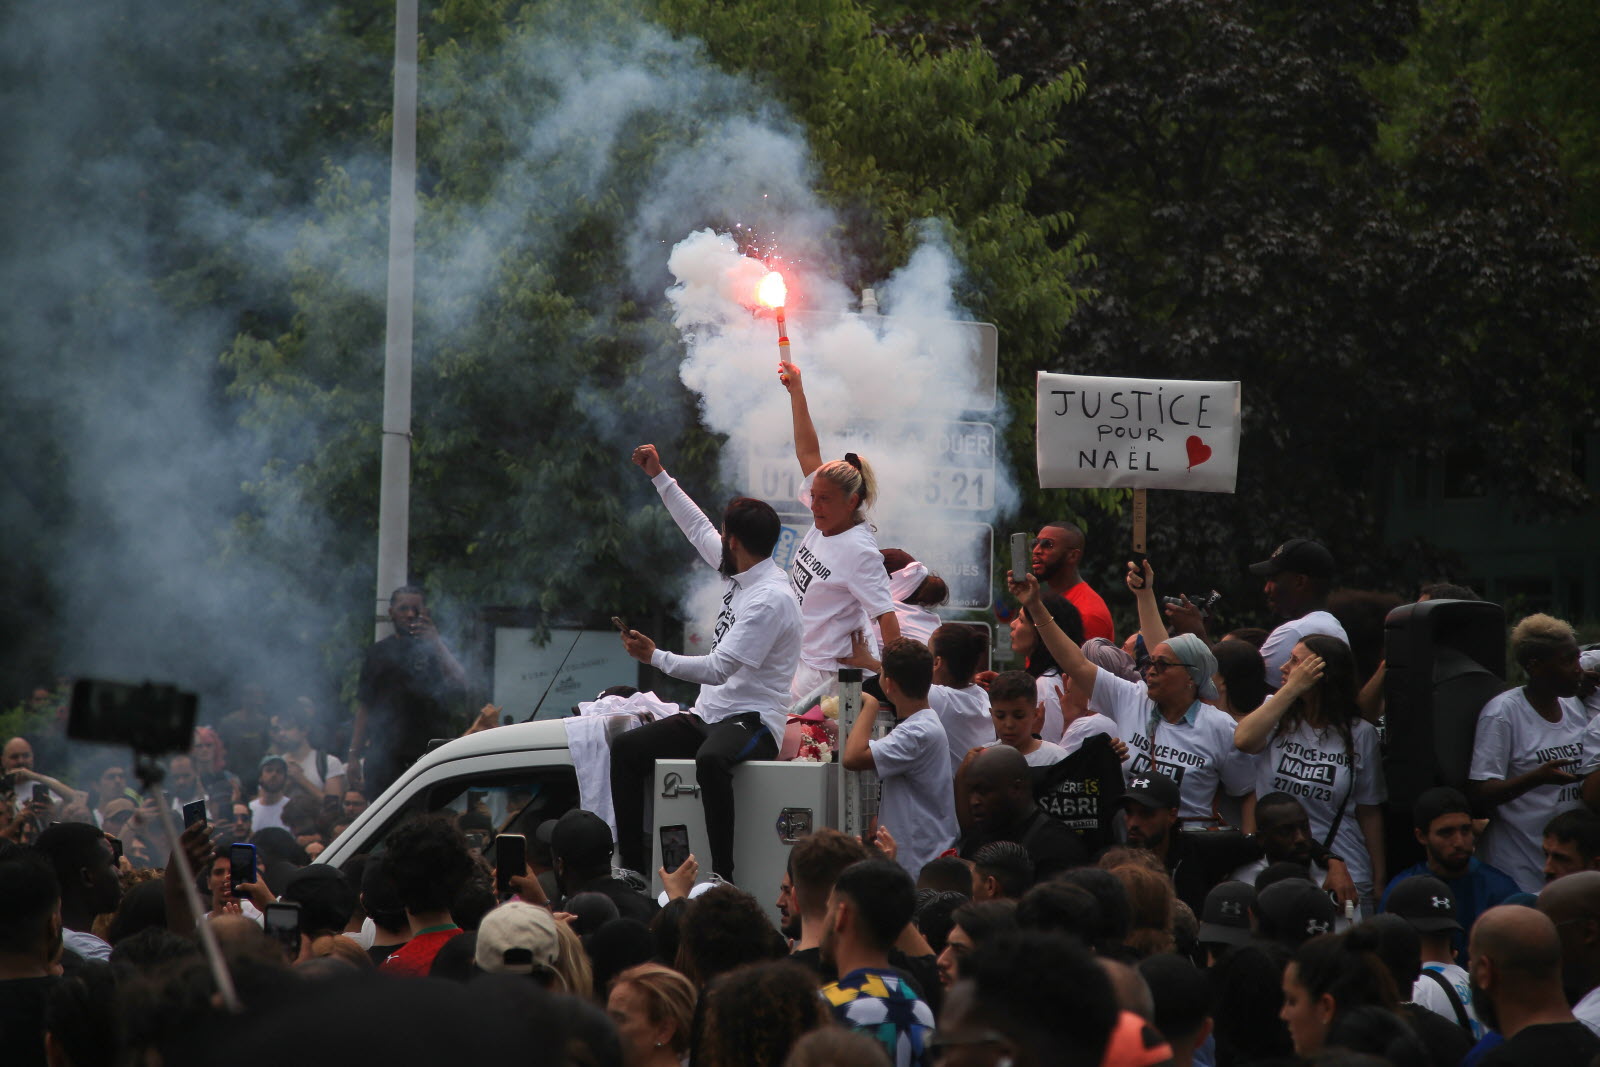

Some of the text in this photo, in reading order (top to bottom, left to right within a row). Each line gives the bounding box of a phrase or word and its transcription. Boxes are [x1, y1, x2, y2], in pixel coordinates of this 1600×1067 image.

[1097, 425, 1165, 442] POUR
[1079, 446, 1160, 472] NAËL
[1129, 732, 1206, 769] JUSCE POUR
[1536, 744, 1578, 764] JUSTICE
[1281, 758, 1332, 783] NAHEL
[1274, 777, 1332, 802] 27/06/23
